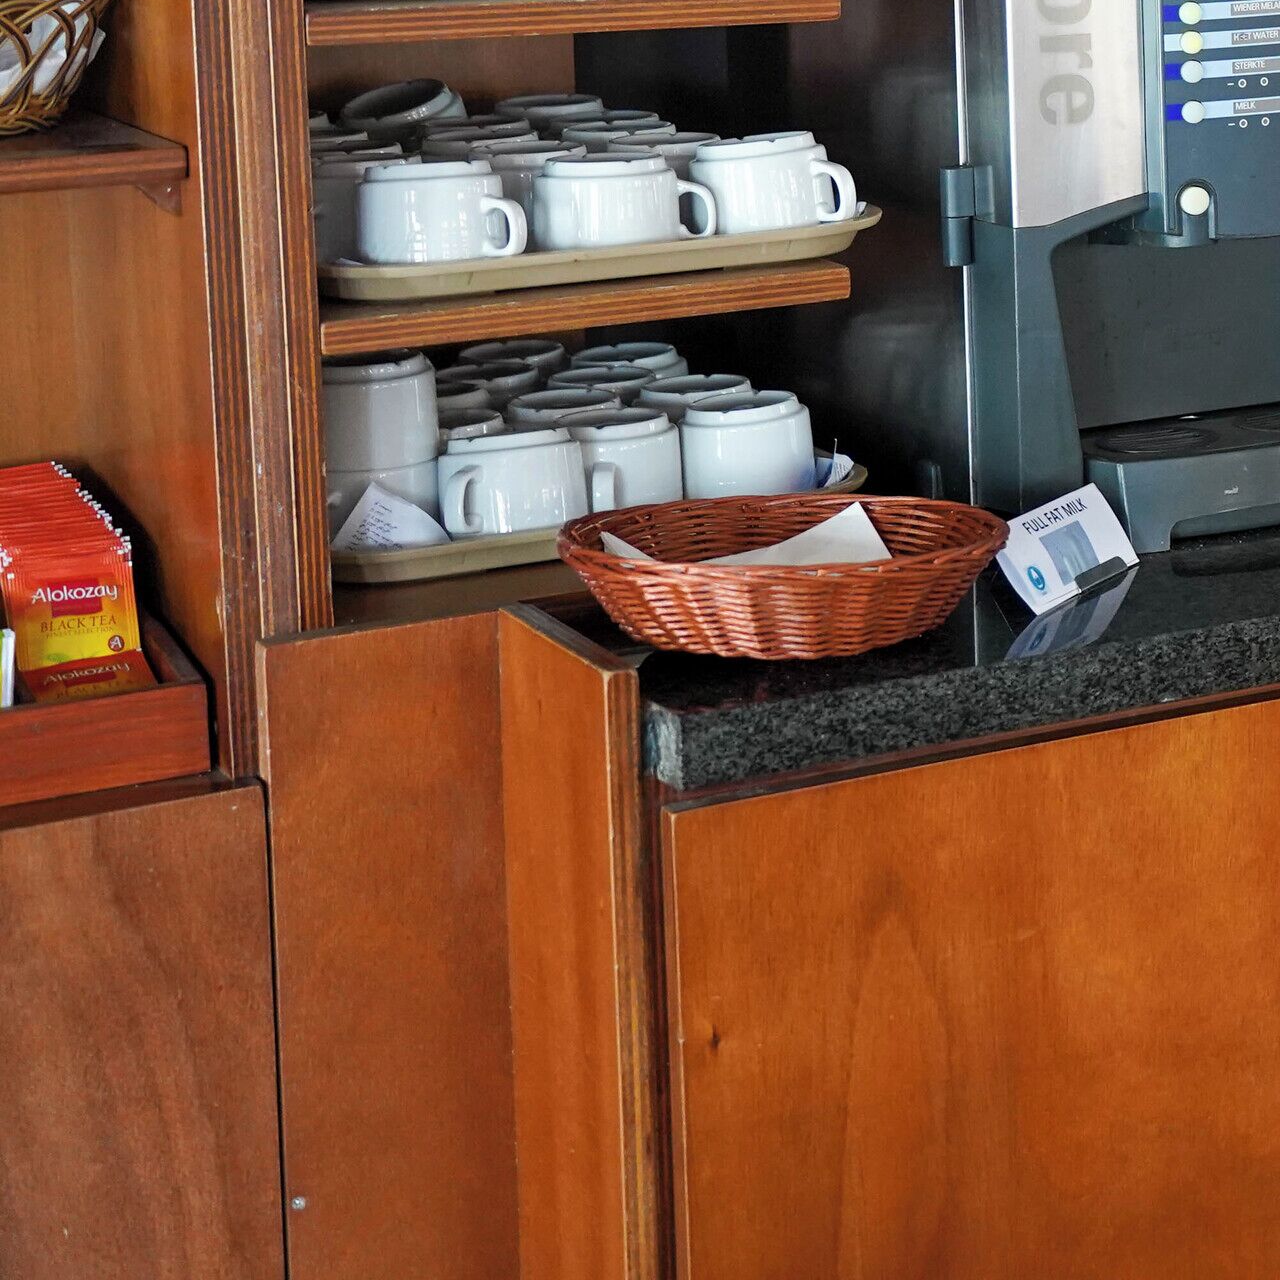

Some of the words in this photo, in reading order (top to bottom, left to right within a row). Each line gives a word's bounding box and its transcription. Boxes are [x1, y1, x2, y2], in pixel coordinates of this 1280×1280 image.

[1233, 2, 1260, 12] WIENER
[1252, 29, 1279, 40] WATER
[1234, 61, 1265, 70] STERKTE
[1235, 101, 1256, 110] MELK
[1022, 516, 1049, 534] FULL
[1044, 507, 1065, 525] FAT
[1061, 498, 1088, 517] MILK
[31, 584, 118, 604] Alokozay
[40, 617, 86, 634] BLACK
[88, 613, 118, 627] TEA
